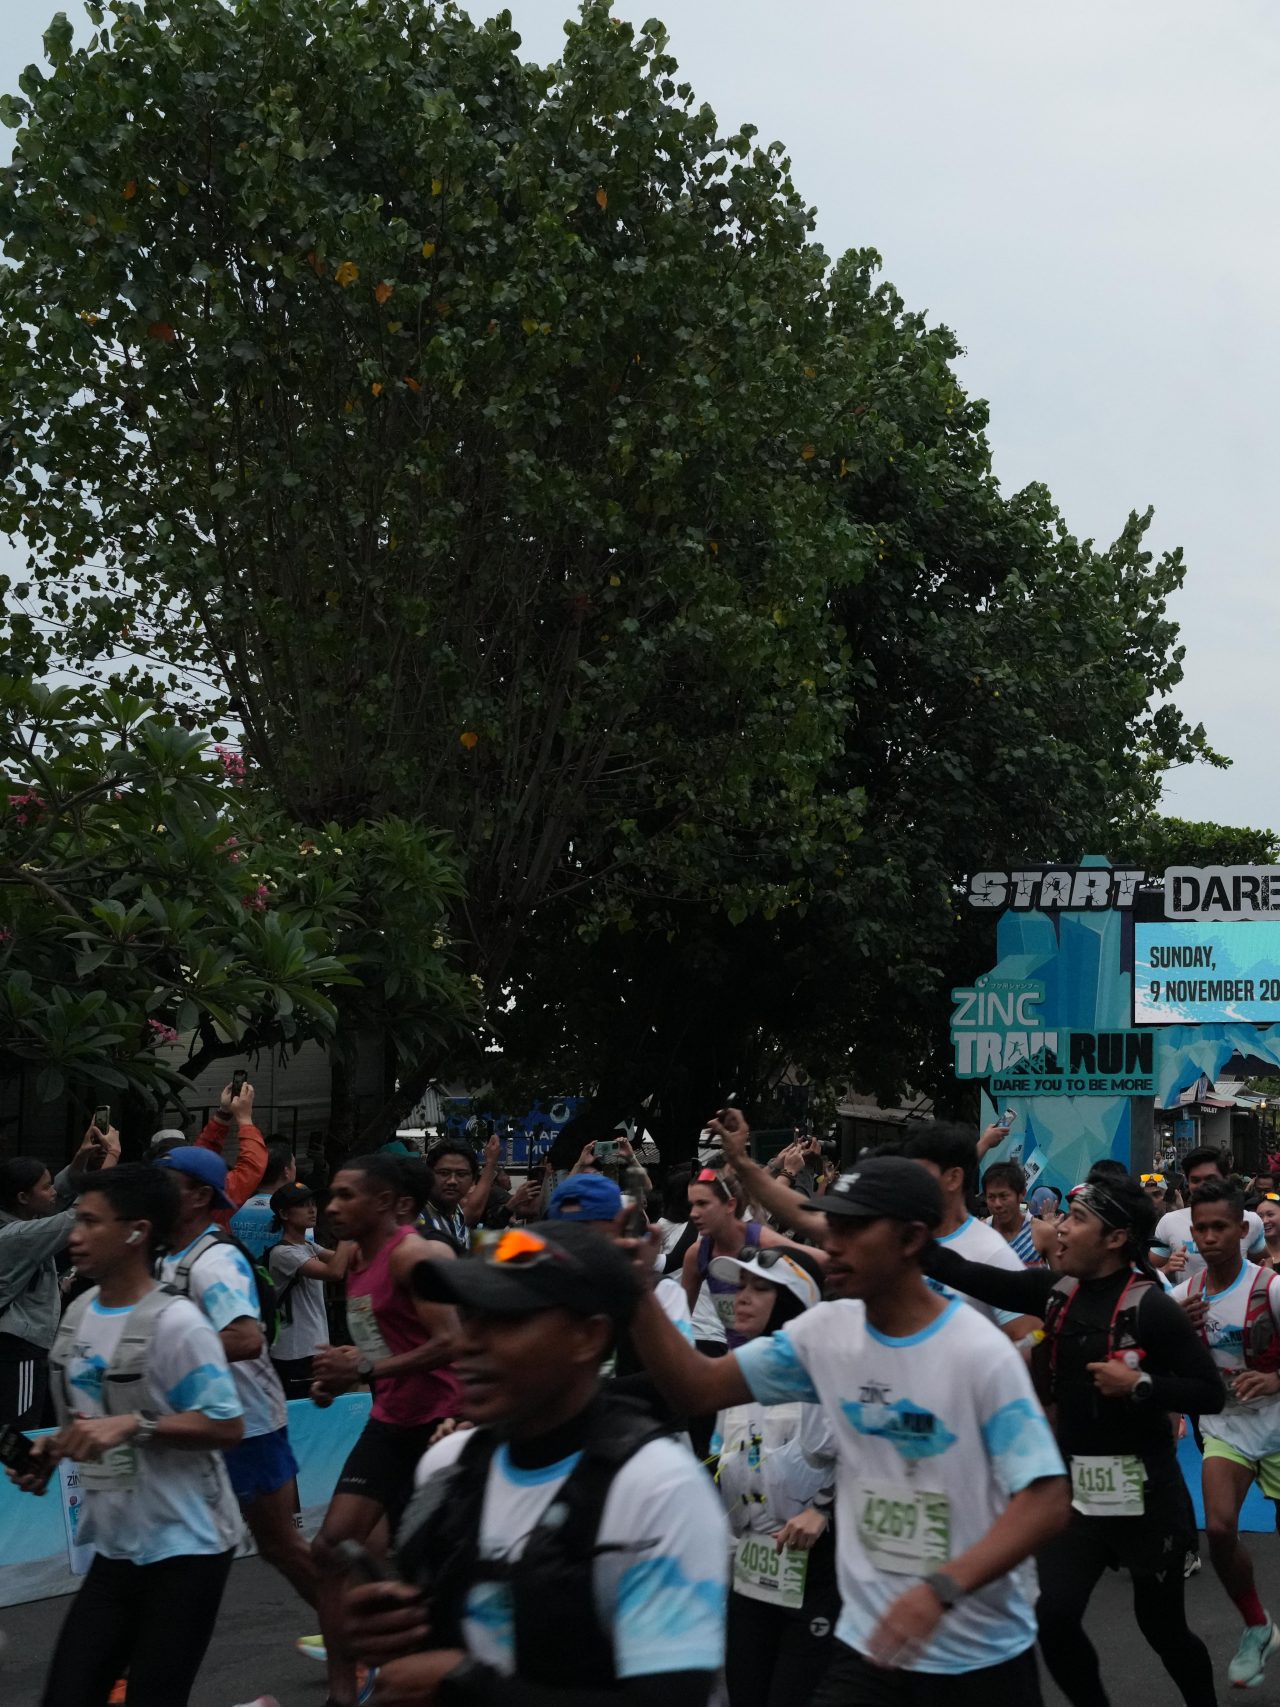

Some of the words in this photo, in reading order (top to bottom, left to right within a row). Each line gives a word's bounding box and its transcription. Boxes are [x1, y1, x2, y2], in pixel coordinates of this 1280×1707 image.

[970, 871, 1145, 907] START
[1150, 946, 1216, 970] SUNDAY,
[1150, 981, 1160, 1003] 9
[1166, 979, 1254, 1002] NOVEMBER
[953, 991, 1040, 1026] ZINC
[953, 1031, 1065, 1074] TRAIL
[1070, 1032, 1154, 1074] RUN
[993, 1079, 1031, 1091] DARE
[1034, 1079, 1060, 1091] YOU
[1067, 1079, 1085, 1091] TO
[1089, 1079, 1107, 1091] BE
[1111, 1079, 1154, 1091] MORE
[1200, 1105, 1218, 1114] TOILET
[66, 1475, 80, 1487] ZIN
[1078, 1466, 1116, 1492] 4151
[740, 1542, 780, 1577] 4035
